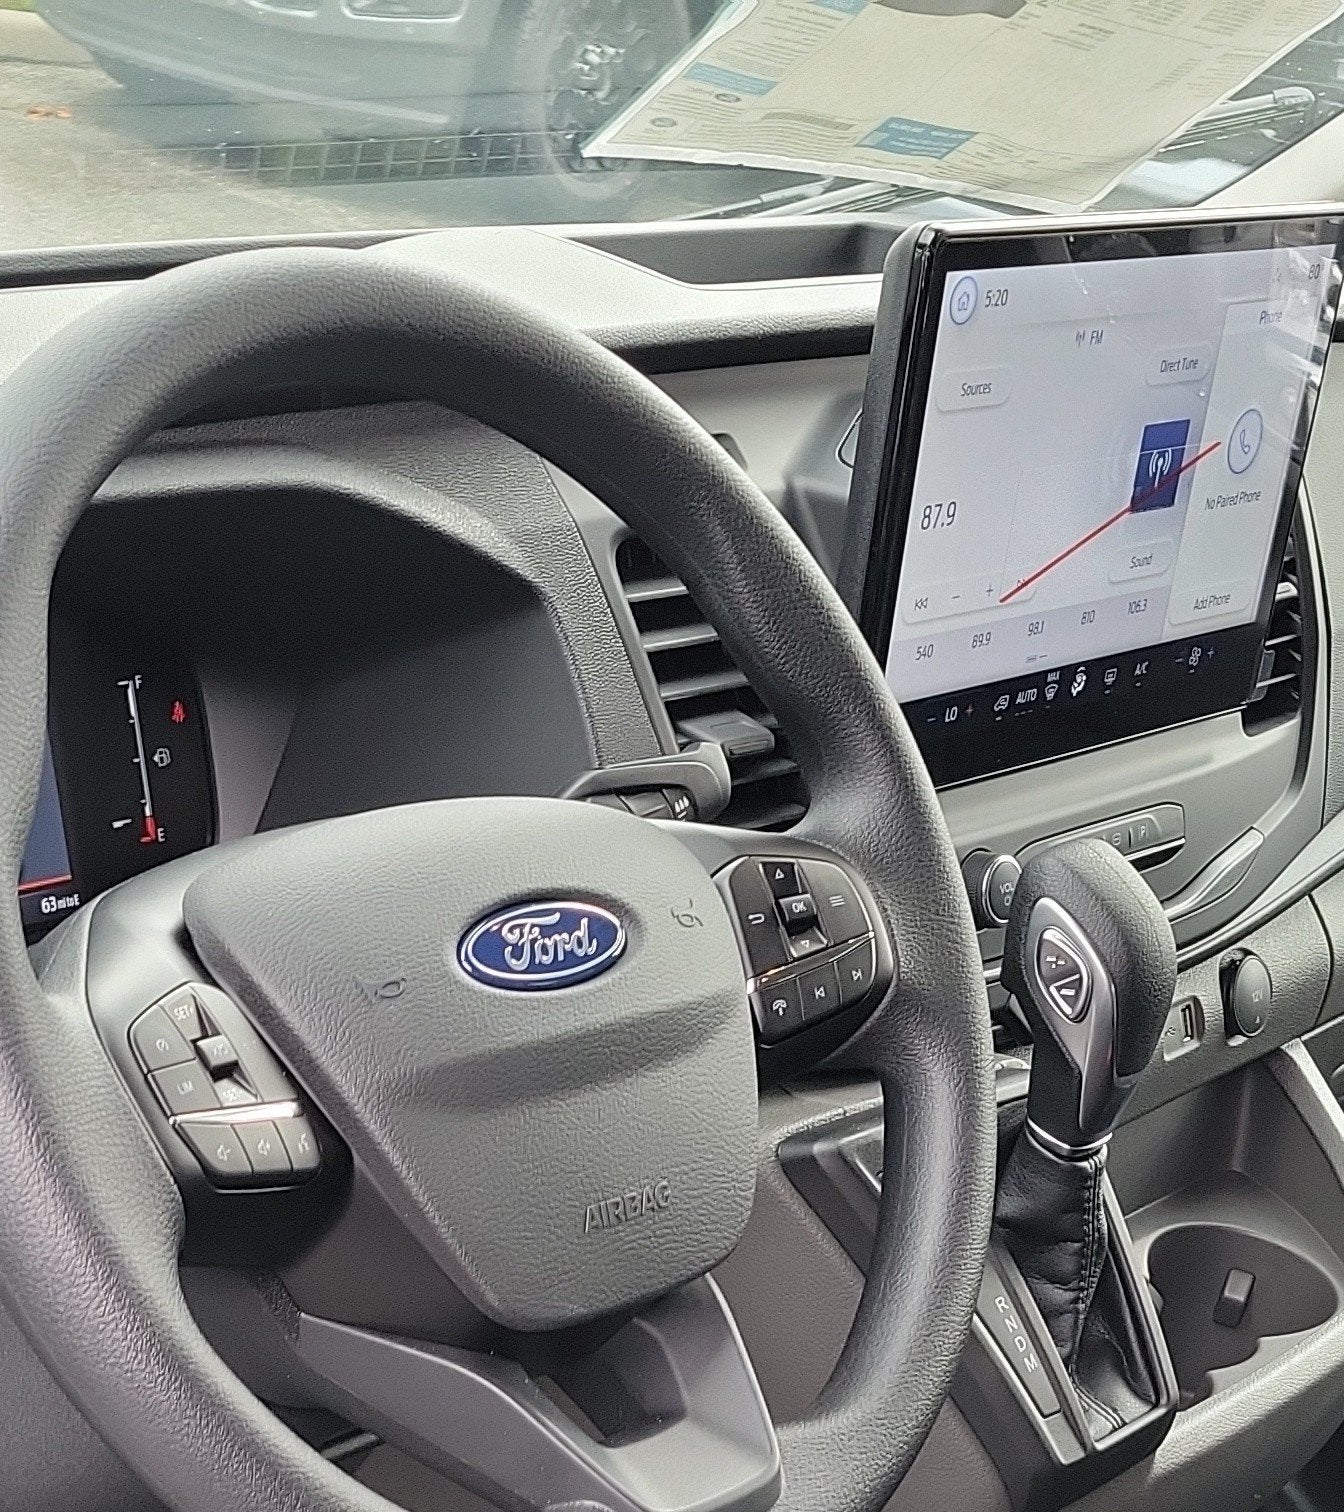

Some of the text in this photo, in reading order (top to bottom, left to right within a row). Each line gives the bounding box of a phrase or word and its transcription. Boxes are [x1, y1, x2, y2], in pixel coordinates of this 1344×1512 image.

[984, 288, 1009, 308] 5:20
[1258, 310, 1283, 325] Phone
[1089, 329, 1104, 346] FM
[1159, 356, 1199, 373] Direct Tune
[960, 382, 992, 397] Sources
[1204, 489, 1262, 511] No Paired Phone
[920, 500, 957, 531] 87.9
[1129, 552, 1153, 569] Sound
[1193, 593, 1231, 611] Add Phone
[914, 643, 934, 661] 540
[1015, 687, 1039, 706] AUTO
[943, 705, 958, 724] LO
[41, 896, 57, 913] 63
[791, 900, 807, 914] OK
[501, 911, 598, 971] Ford
[176, 1080, 196, 1096] LIM
[583, 1179, 672, 1235] AIRBAG
[994, 1296, 1038, 1374] R N D M
